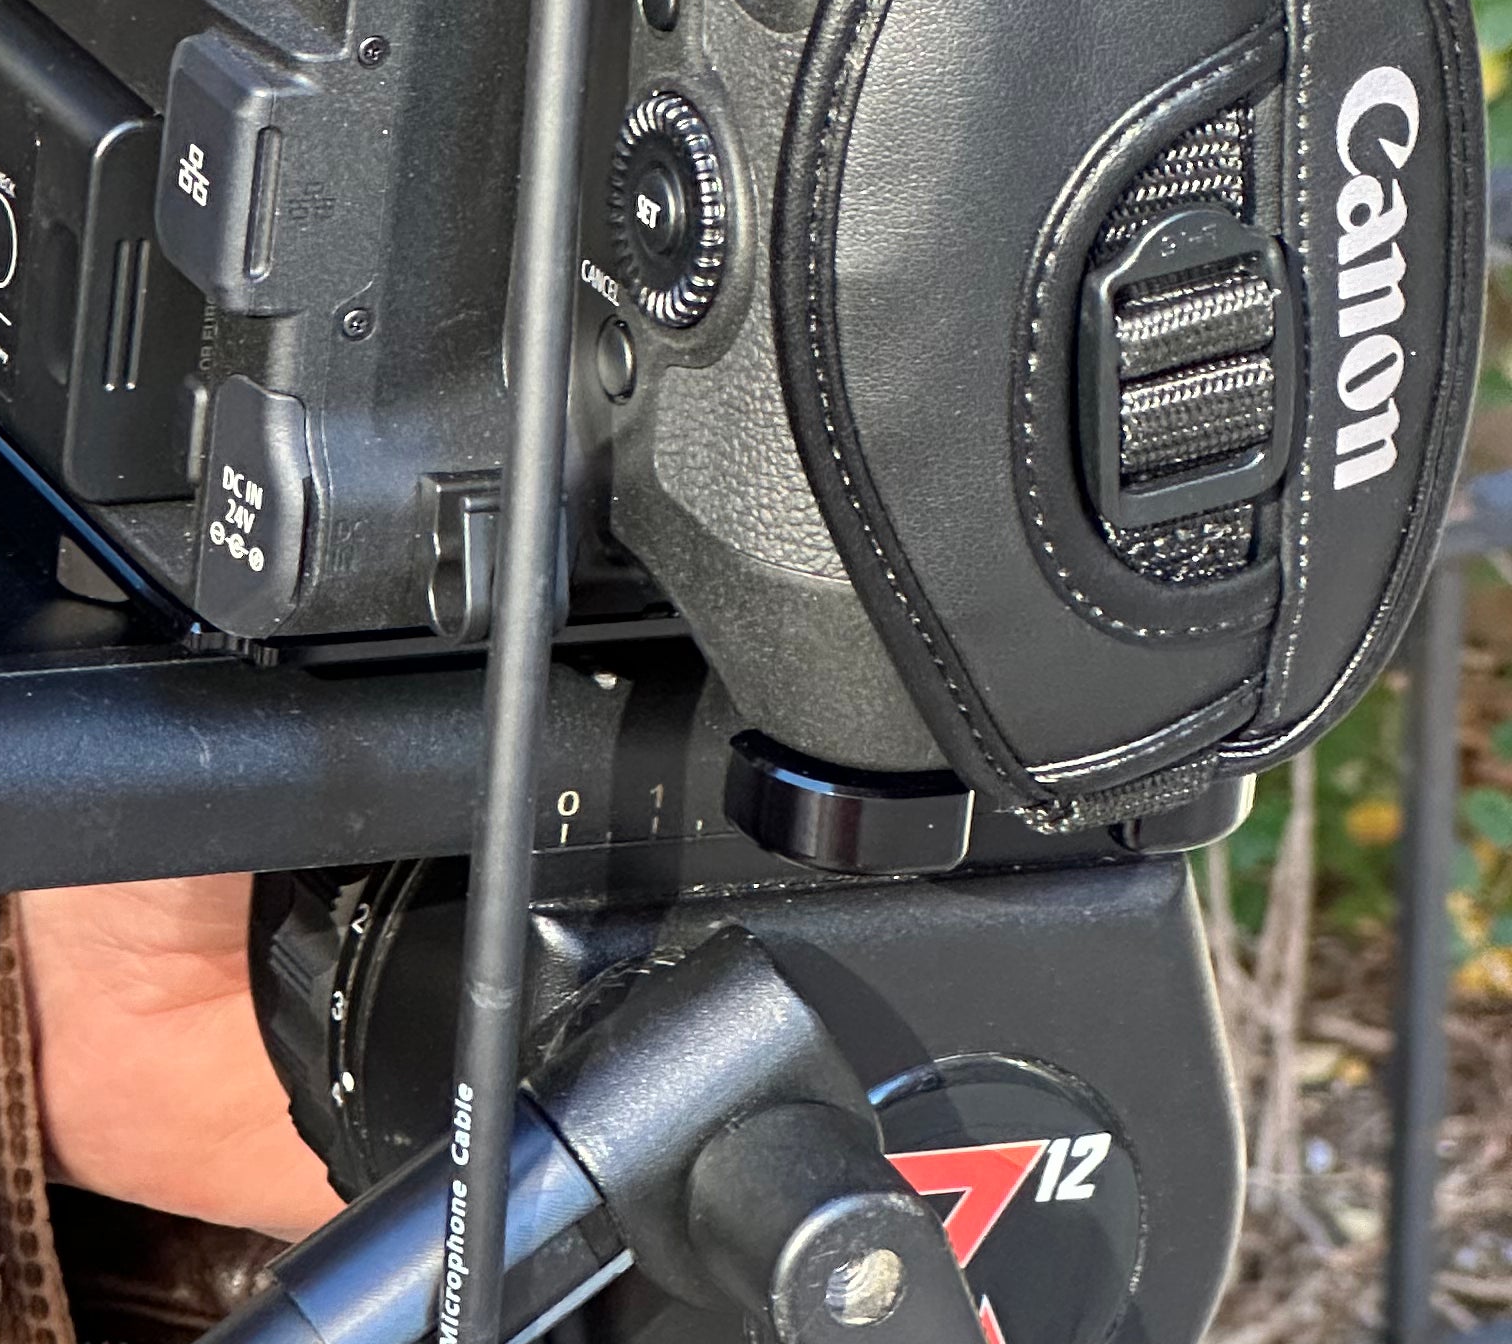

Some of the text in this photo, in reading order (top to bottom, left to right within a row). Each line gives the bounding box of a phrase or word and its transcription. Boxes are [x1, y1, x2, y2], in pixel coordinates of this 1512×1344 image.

[636, 194, 662, 229] SET
[581, 259, 620, 307] CANCEL
[1334, 65, 1419, 491] Canon
[222, 465, 264, 510] DC IN
[225, 498, 256, 534] 24V
[556, 789, 581, 817] 0
[649, 782, 665, 809] 1
[351, 902, 370, 935] 2
[331, 990, 345, 1021] 3
[1034, 1131, 1112, 1203] 12
[439, 1082, 474, 1344] Microphone Cable
